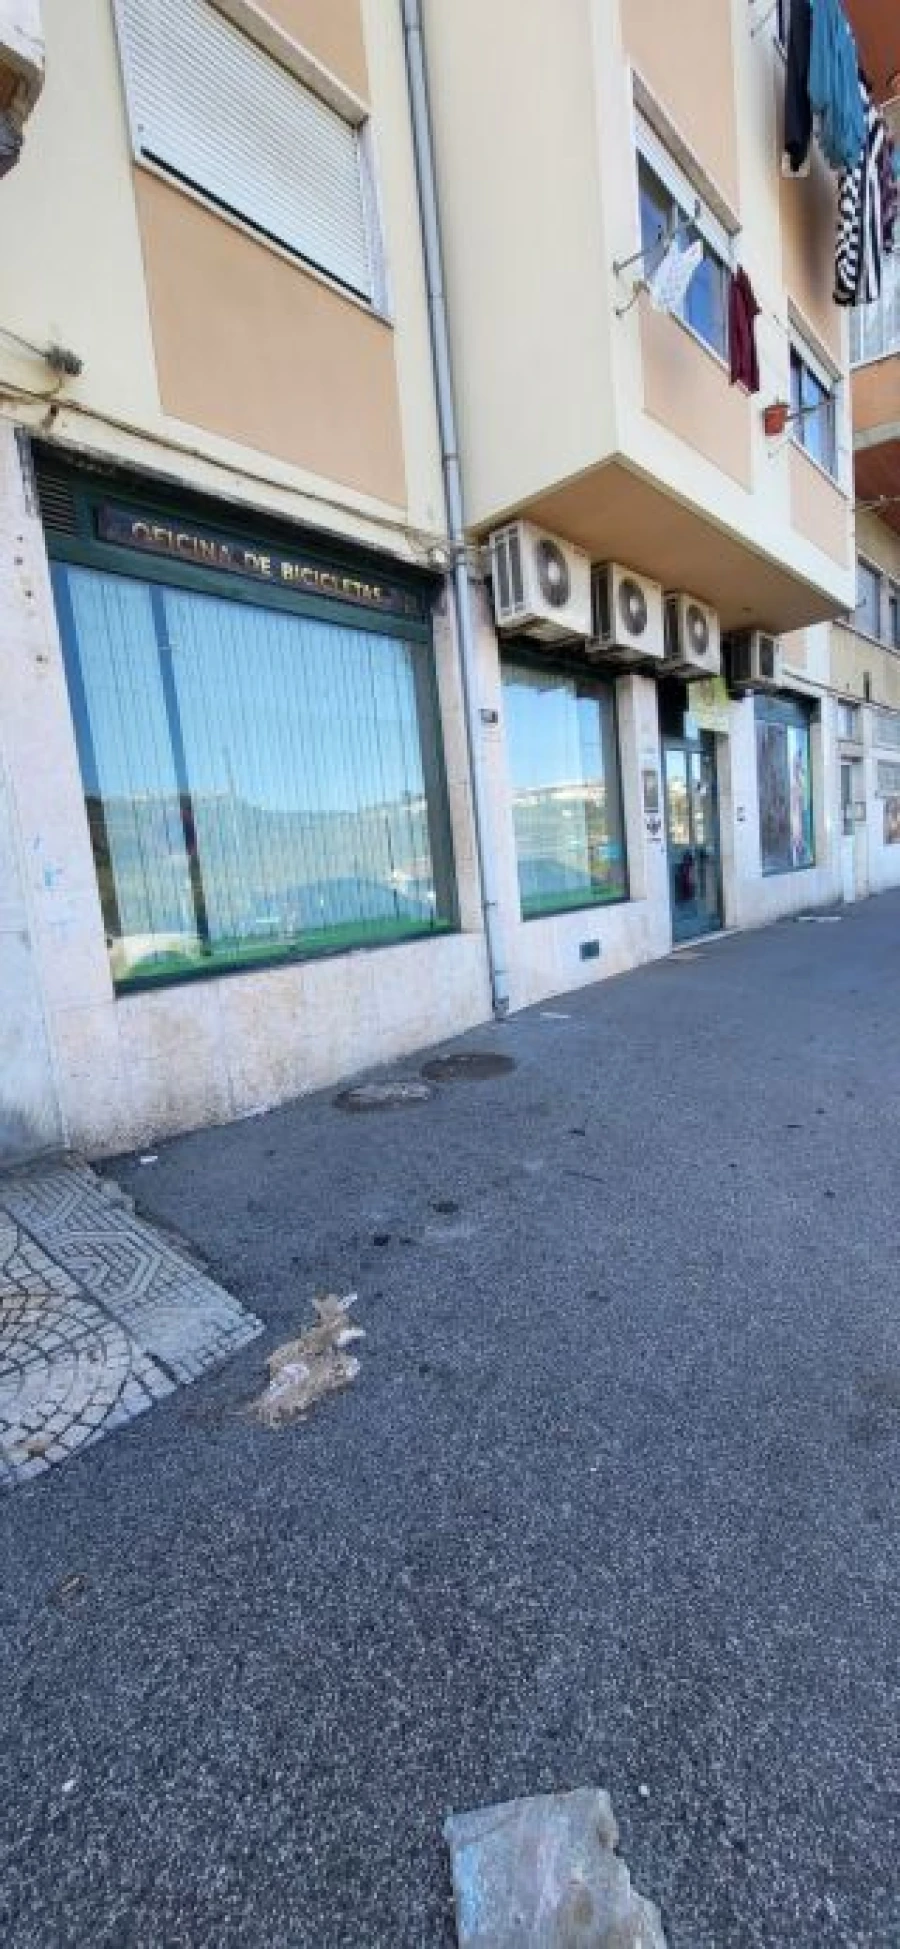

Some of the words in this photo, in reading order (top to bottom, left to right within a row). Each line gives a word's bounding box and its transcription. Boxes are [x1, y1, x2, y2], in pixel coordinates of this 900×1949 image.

[131, 521, 232, 564] OFICINA
[244, 551, 272, 576] DE
[281, 562, 382, 602] BICICLETAS
